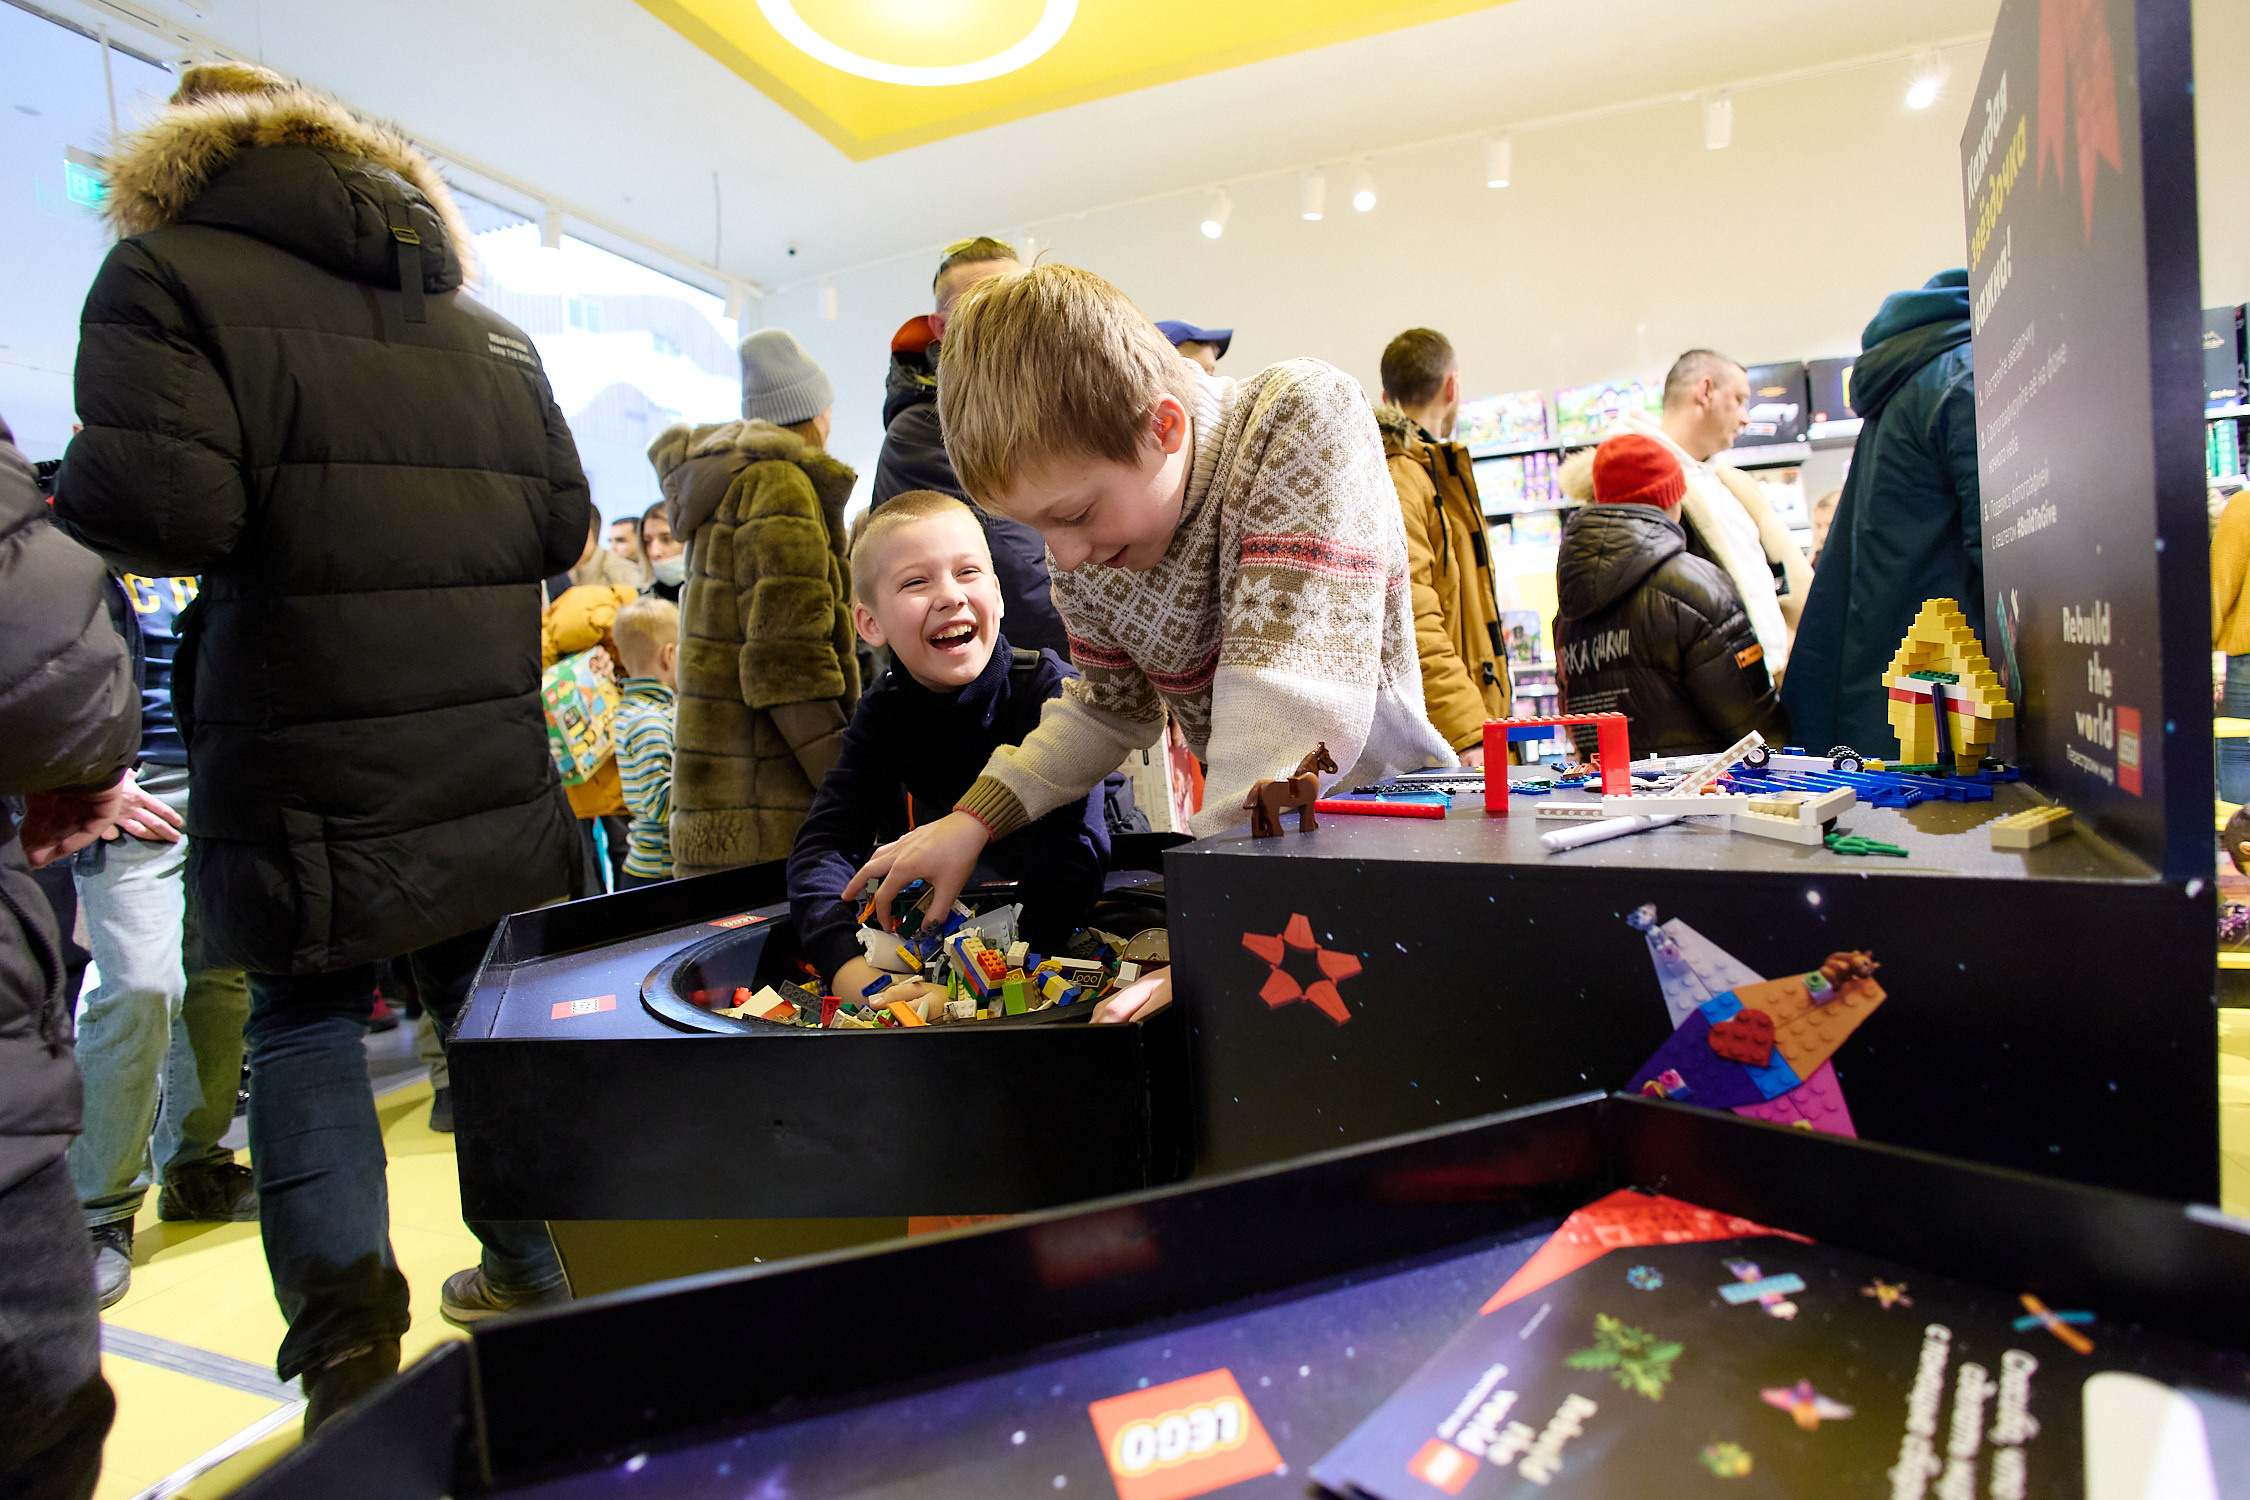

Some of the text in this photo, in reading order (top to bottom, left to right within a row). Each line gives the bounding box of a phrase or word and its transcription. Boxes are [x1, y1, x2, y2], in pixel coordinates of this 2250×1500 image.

[1967, 69, 2007, 210] Каждая
[1972, 114, 2026, 272] звёздочка
[1974, 223, 2012, 336] важна!
[2017, 498, 2057, 539] #BuildToGive
[2062, 600, 2112, 647] Rebuild
[2087, 650, 2113, 699] the
[2075, 702, 2114, 750] world
[1114, 1398, 1247, 1475] LEGO
